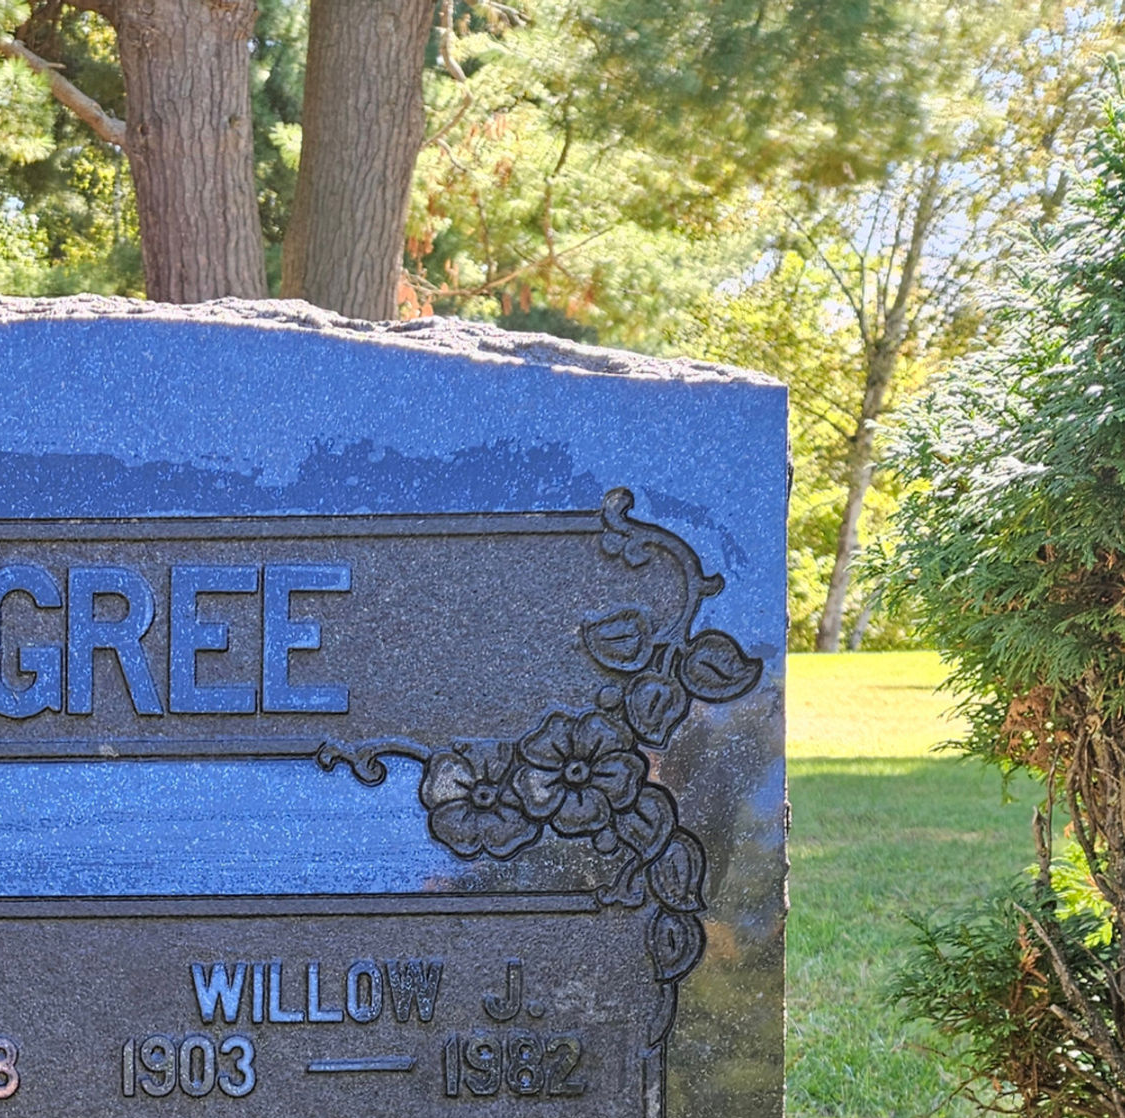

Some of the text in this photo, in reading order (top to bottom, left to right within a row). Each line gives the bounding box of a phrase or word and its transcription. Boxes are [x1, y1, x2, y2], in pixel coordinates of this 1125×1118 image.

[190, 958, 546, 1024] WILLOW J.
[121, 1031, 586, 1098] 1903 1982
